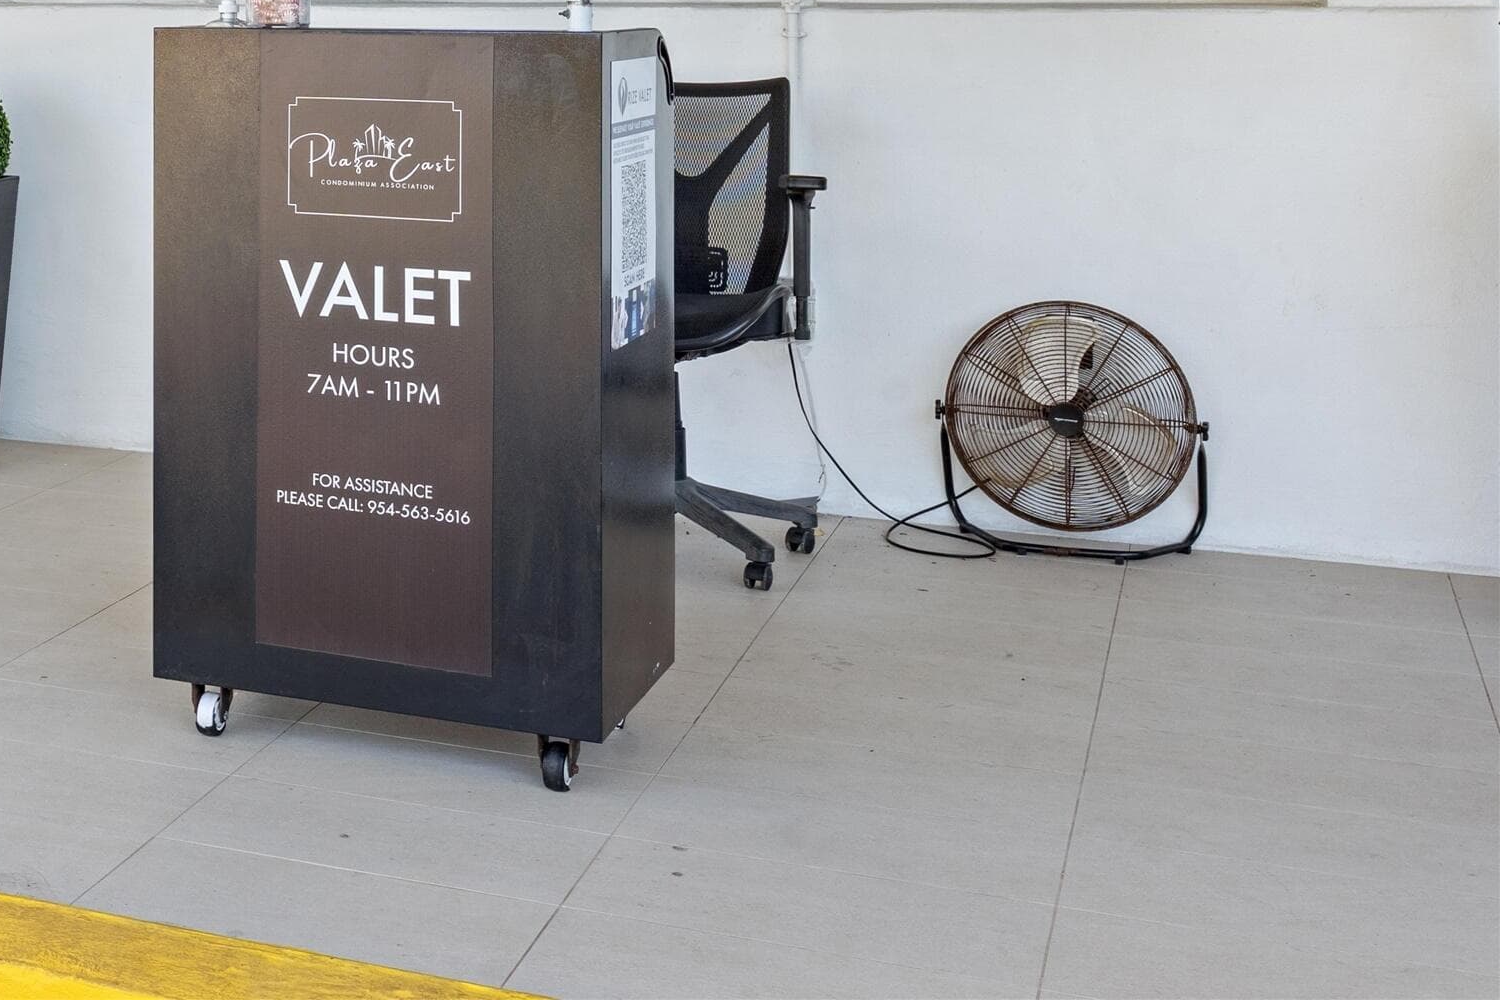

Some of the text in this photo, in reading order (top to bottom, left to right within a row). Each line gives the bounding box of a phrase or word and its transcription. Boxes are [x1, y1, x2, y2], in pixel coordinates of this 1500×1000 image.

[288, 132, 456, 183] Plaza East
[320, 179, 435, 191] CONDOMINIUM ASSOCIATION
[279, 259, 471, 327] VALET
[332, 343, 415, 369] HOURS
[306, 373, 360, 399] 7AM
[384, 380, 441, 405] 11PM
[312, 473, 433, 499] FOR ASSISTANCE
[276, 489, 471, 525] PLEASE CALL: 954-563-5616
